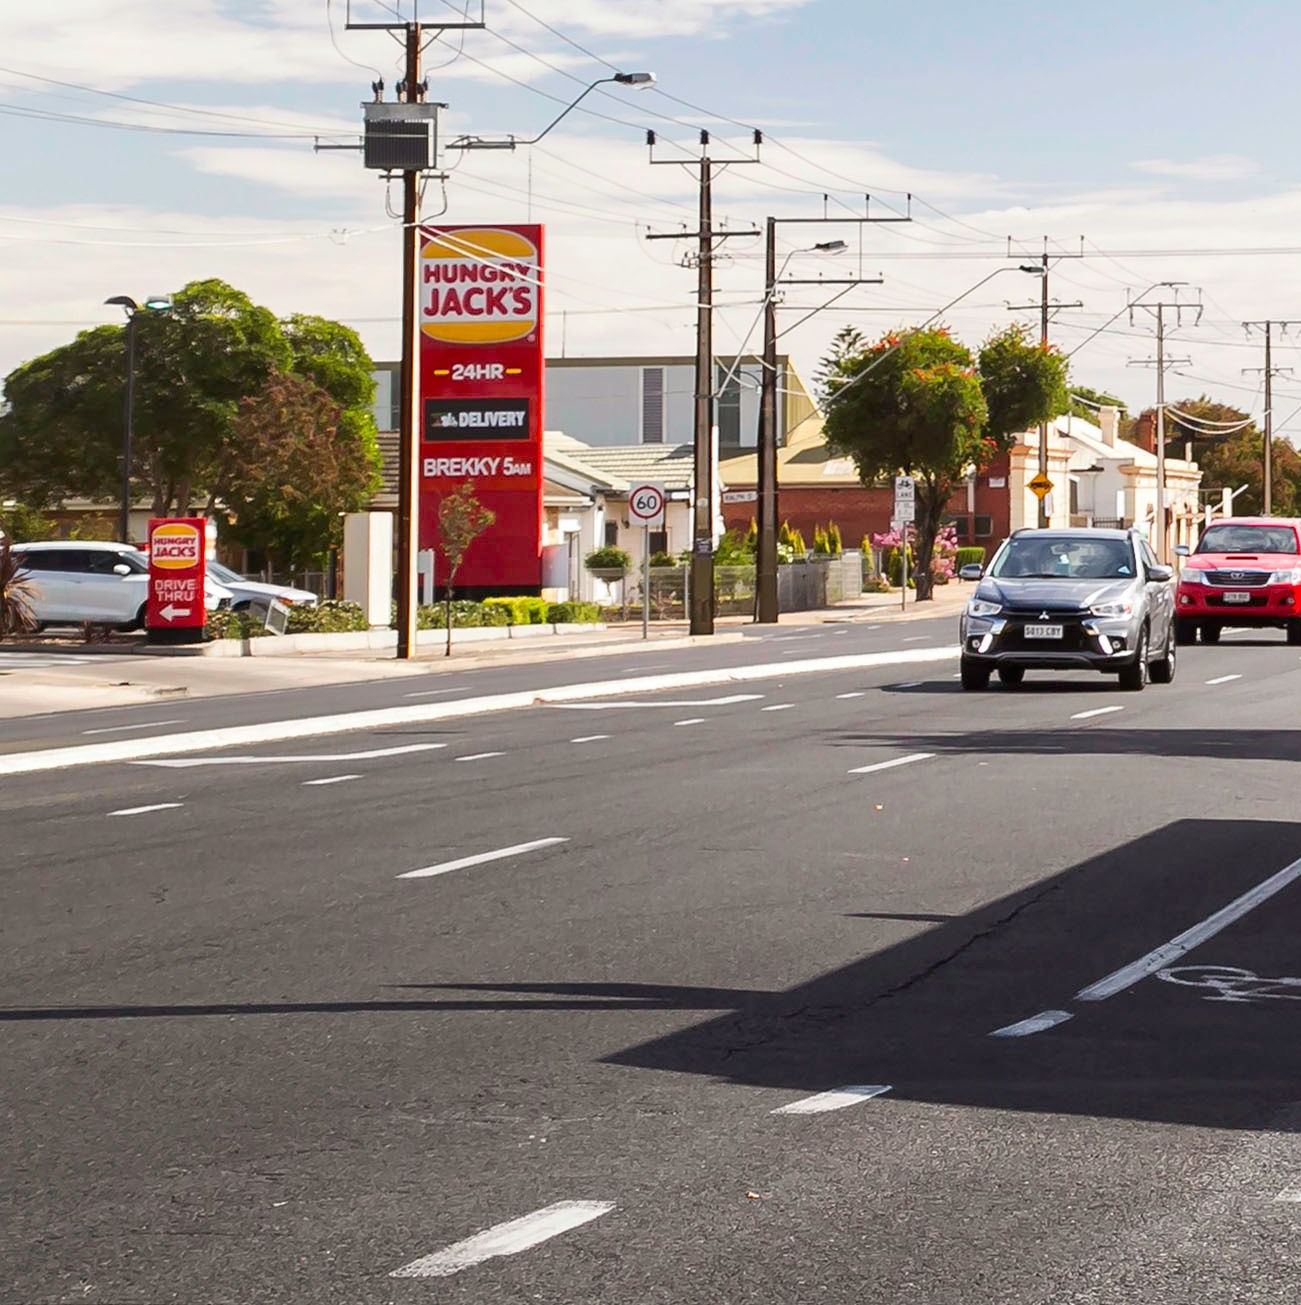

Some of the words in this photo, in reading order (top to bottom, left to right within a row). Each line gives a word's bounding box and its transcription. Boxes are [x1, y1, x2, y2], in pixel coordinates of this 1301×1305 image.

[423, 262, 533, 284] HUNGRY
[423, 286, 532, 316] JACK'S
[451, 363, 505, 381] 24HR
[459, 411, 526, 428] DELIVERY
[423, 457, 501, 477] BREKKY
[503, 457, 532, 476] 5AM
[637, 495, 658, 510] 60
[155, 580, 197, 590] DRIVE
[156, 590, 194, 602] THRU
